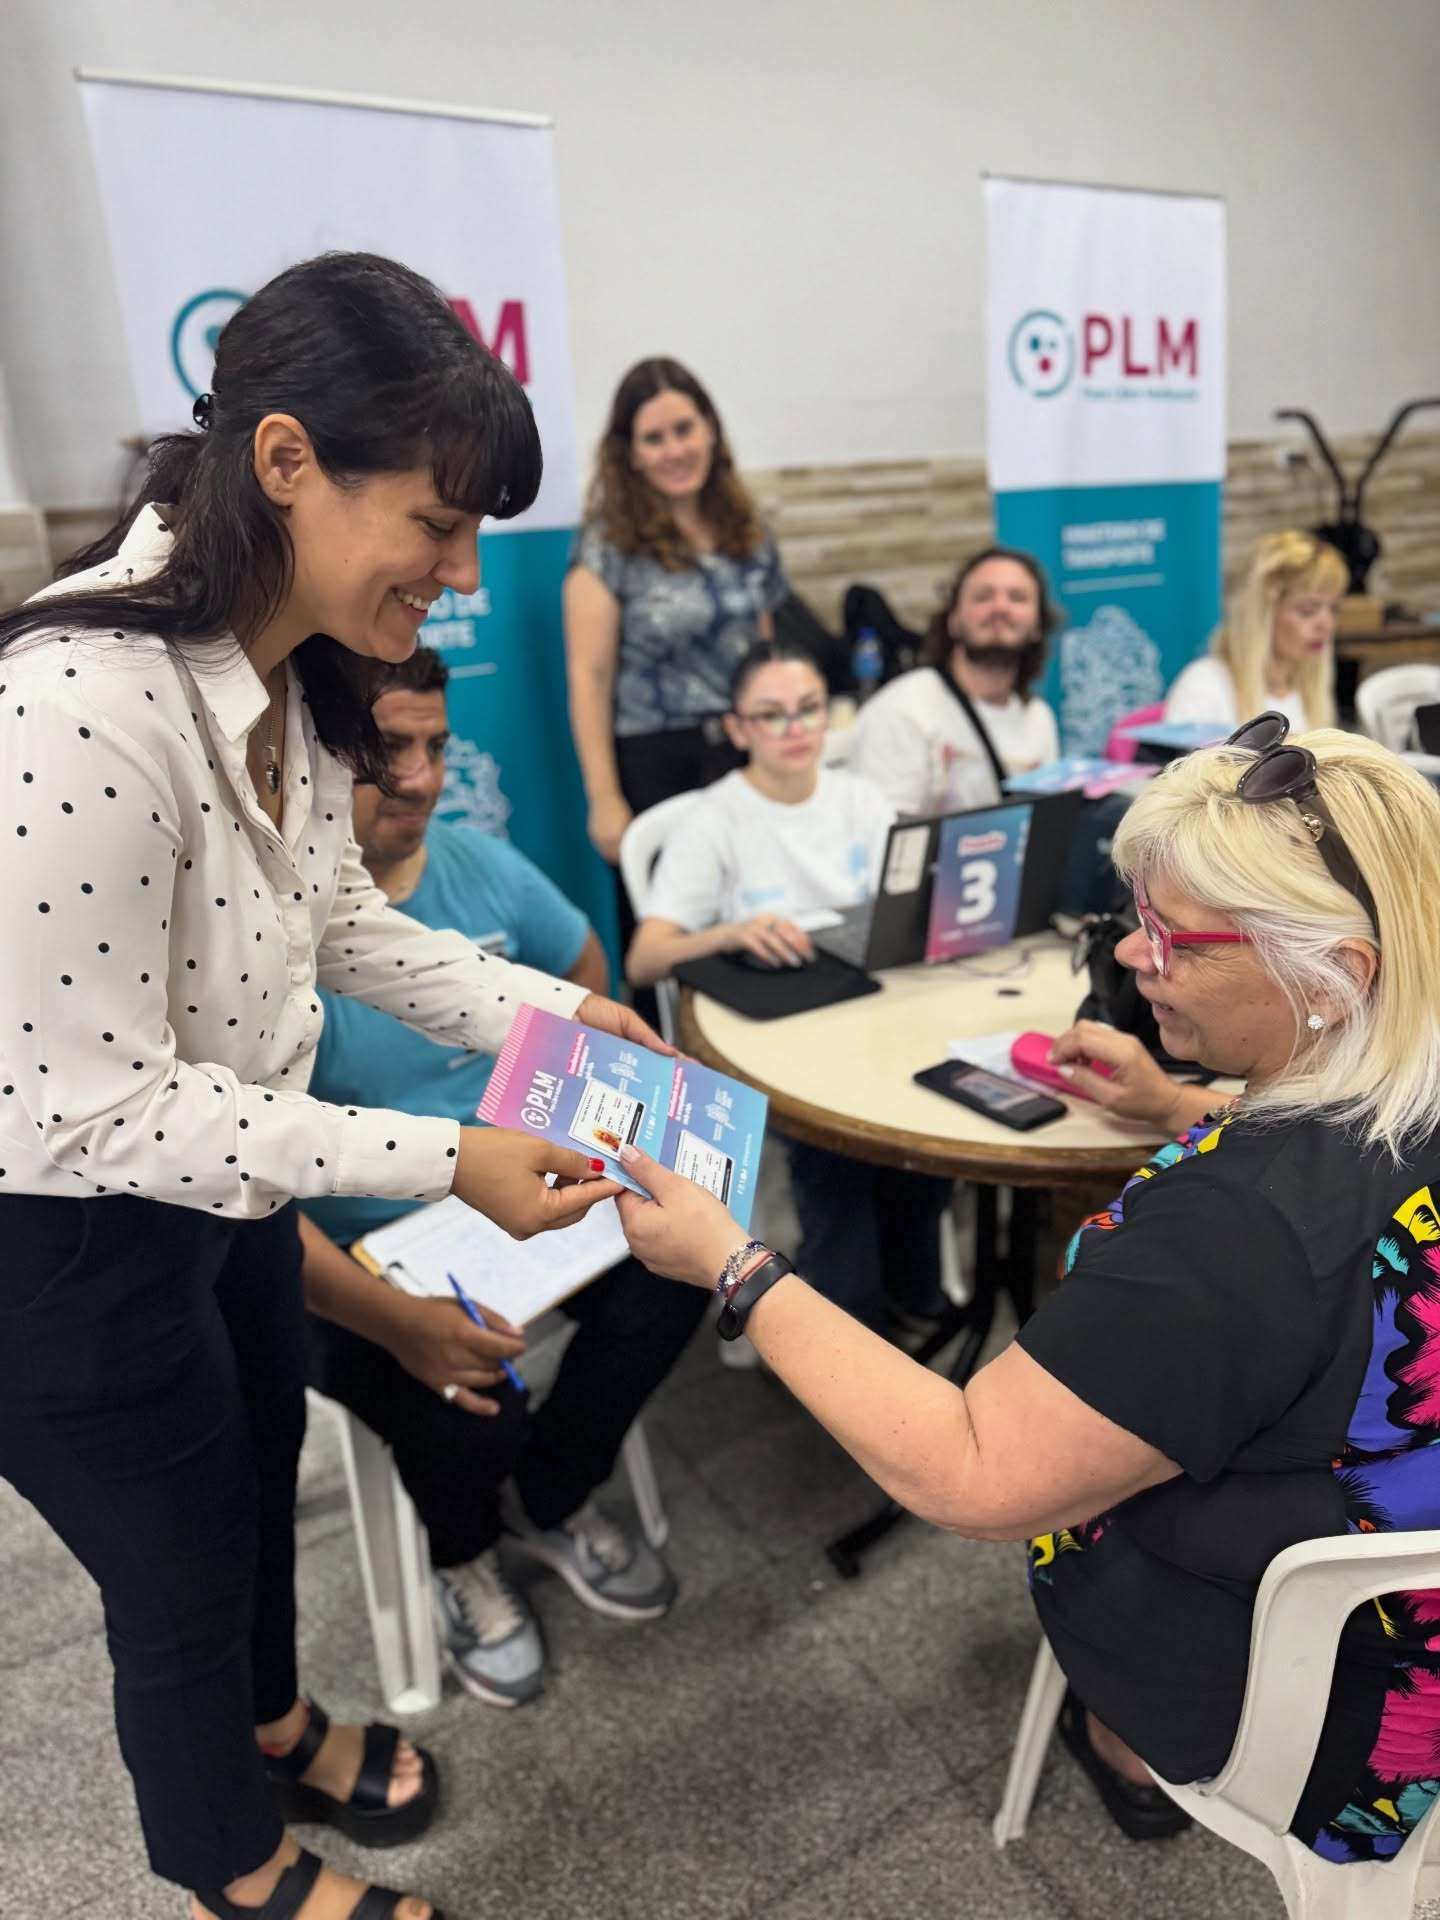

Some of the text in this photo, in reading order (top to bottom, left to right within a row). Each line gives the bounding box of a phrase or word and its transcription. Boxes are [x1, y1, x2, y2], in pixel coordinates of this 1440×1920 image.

[1083, 313, 1198, 378] PLM
[956, 859, 998, 925] 3
[525, 1070, 558, 1110] PLM
